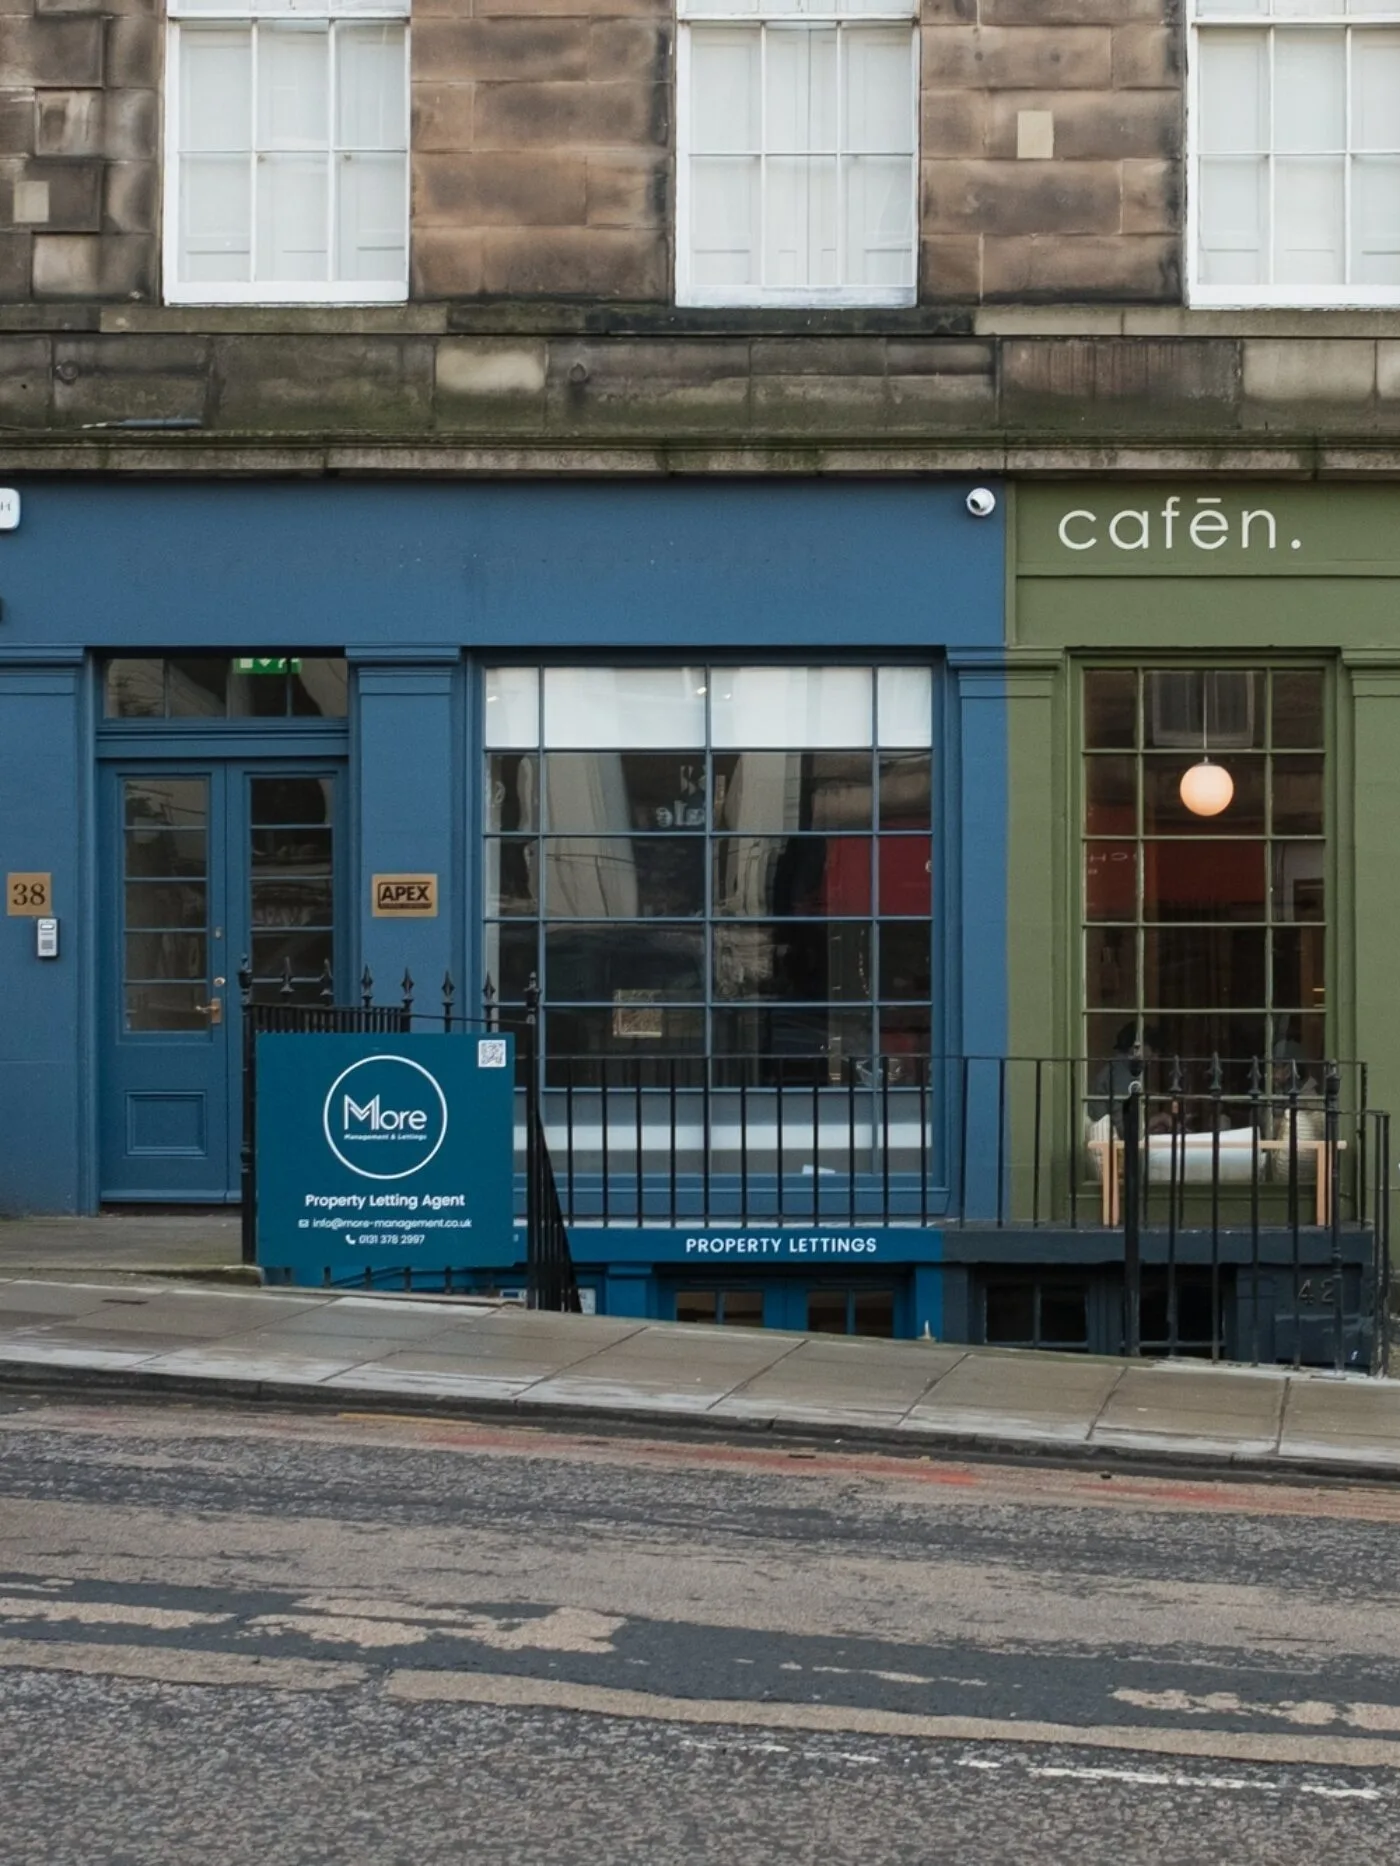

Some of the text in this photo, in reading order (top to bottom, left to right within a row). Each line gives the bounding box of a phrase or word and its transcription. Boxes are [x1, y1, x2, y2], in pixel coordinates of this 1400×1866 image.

[1058, 496, 1301, 550] cafēn.
[13, 883, 46, 906] 38
[381, 885, 430, 902] APEX
[343, 1093, 428, 1130] More
[305, 1193, 466, 1210] Property Letting Agent
[313, 1217, 473, 1230] info@more-management.co.uk
[358, 1233, 378, 1245] 0131
[686, 1238, 877, 1253] PROPERTY LETTINGS
[1297, 1278, 1335, 1304] 42
